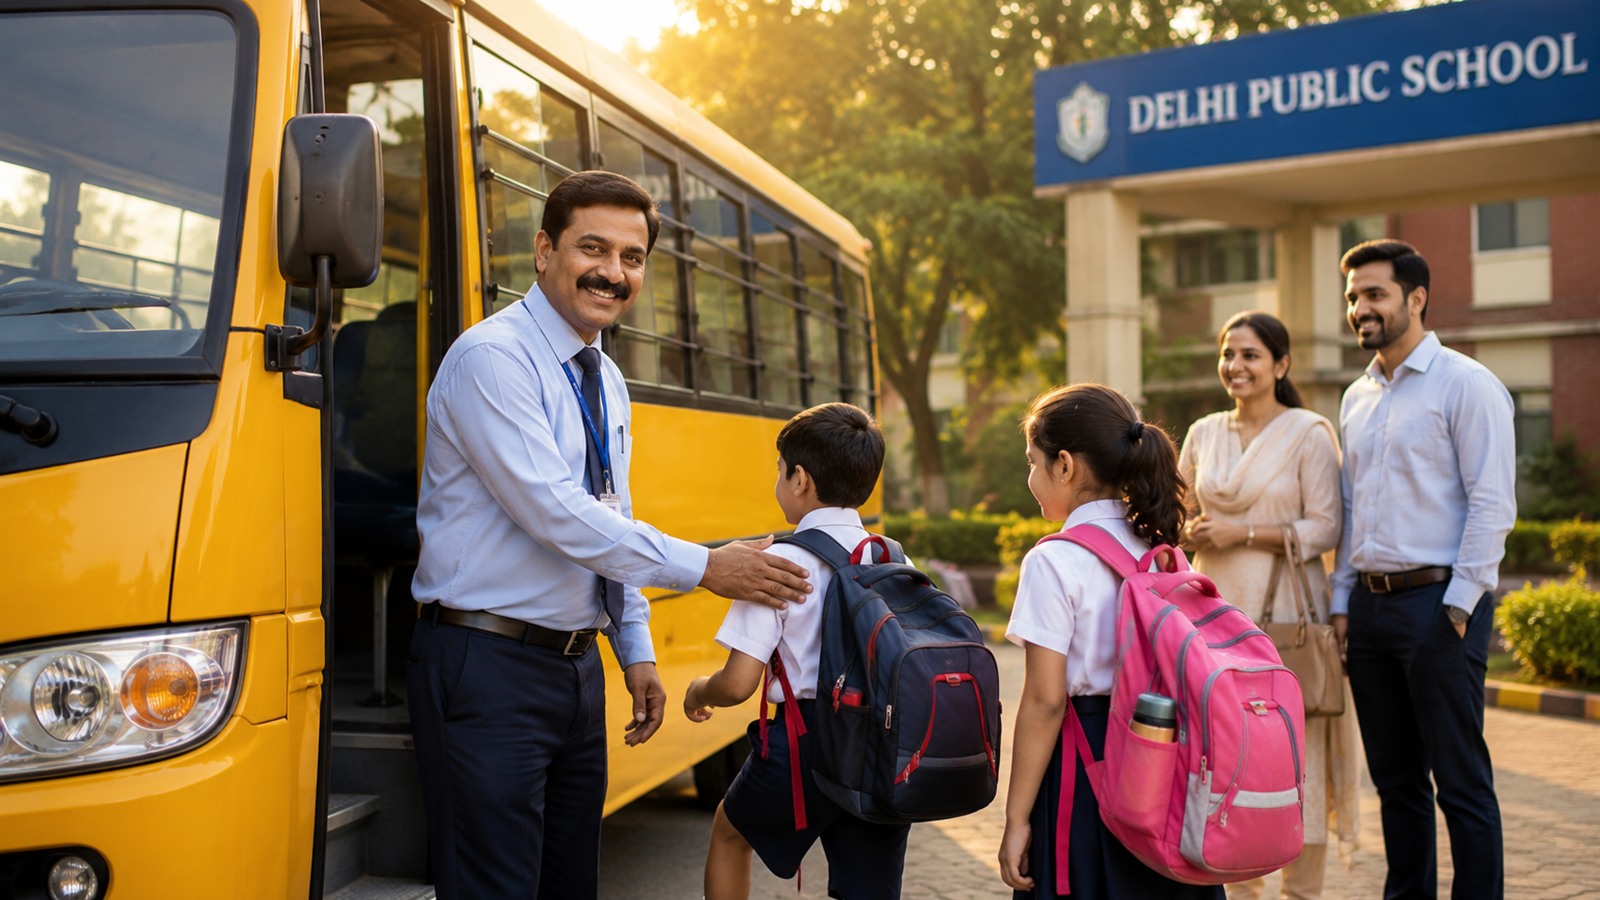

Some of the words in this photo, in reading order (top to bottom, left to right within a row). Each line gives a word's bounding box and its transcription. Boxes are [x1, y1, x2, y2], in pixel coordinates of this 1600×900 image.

[1129, 83, 1238, 134] DELHI
[1248, 61, 1390, 118] PUBLIC
[1401, 33, 1588, 97] SCHOOL
